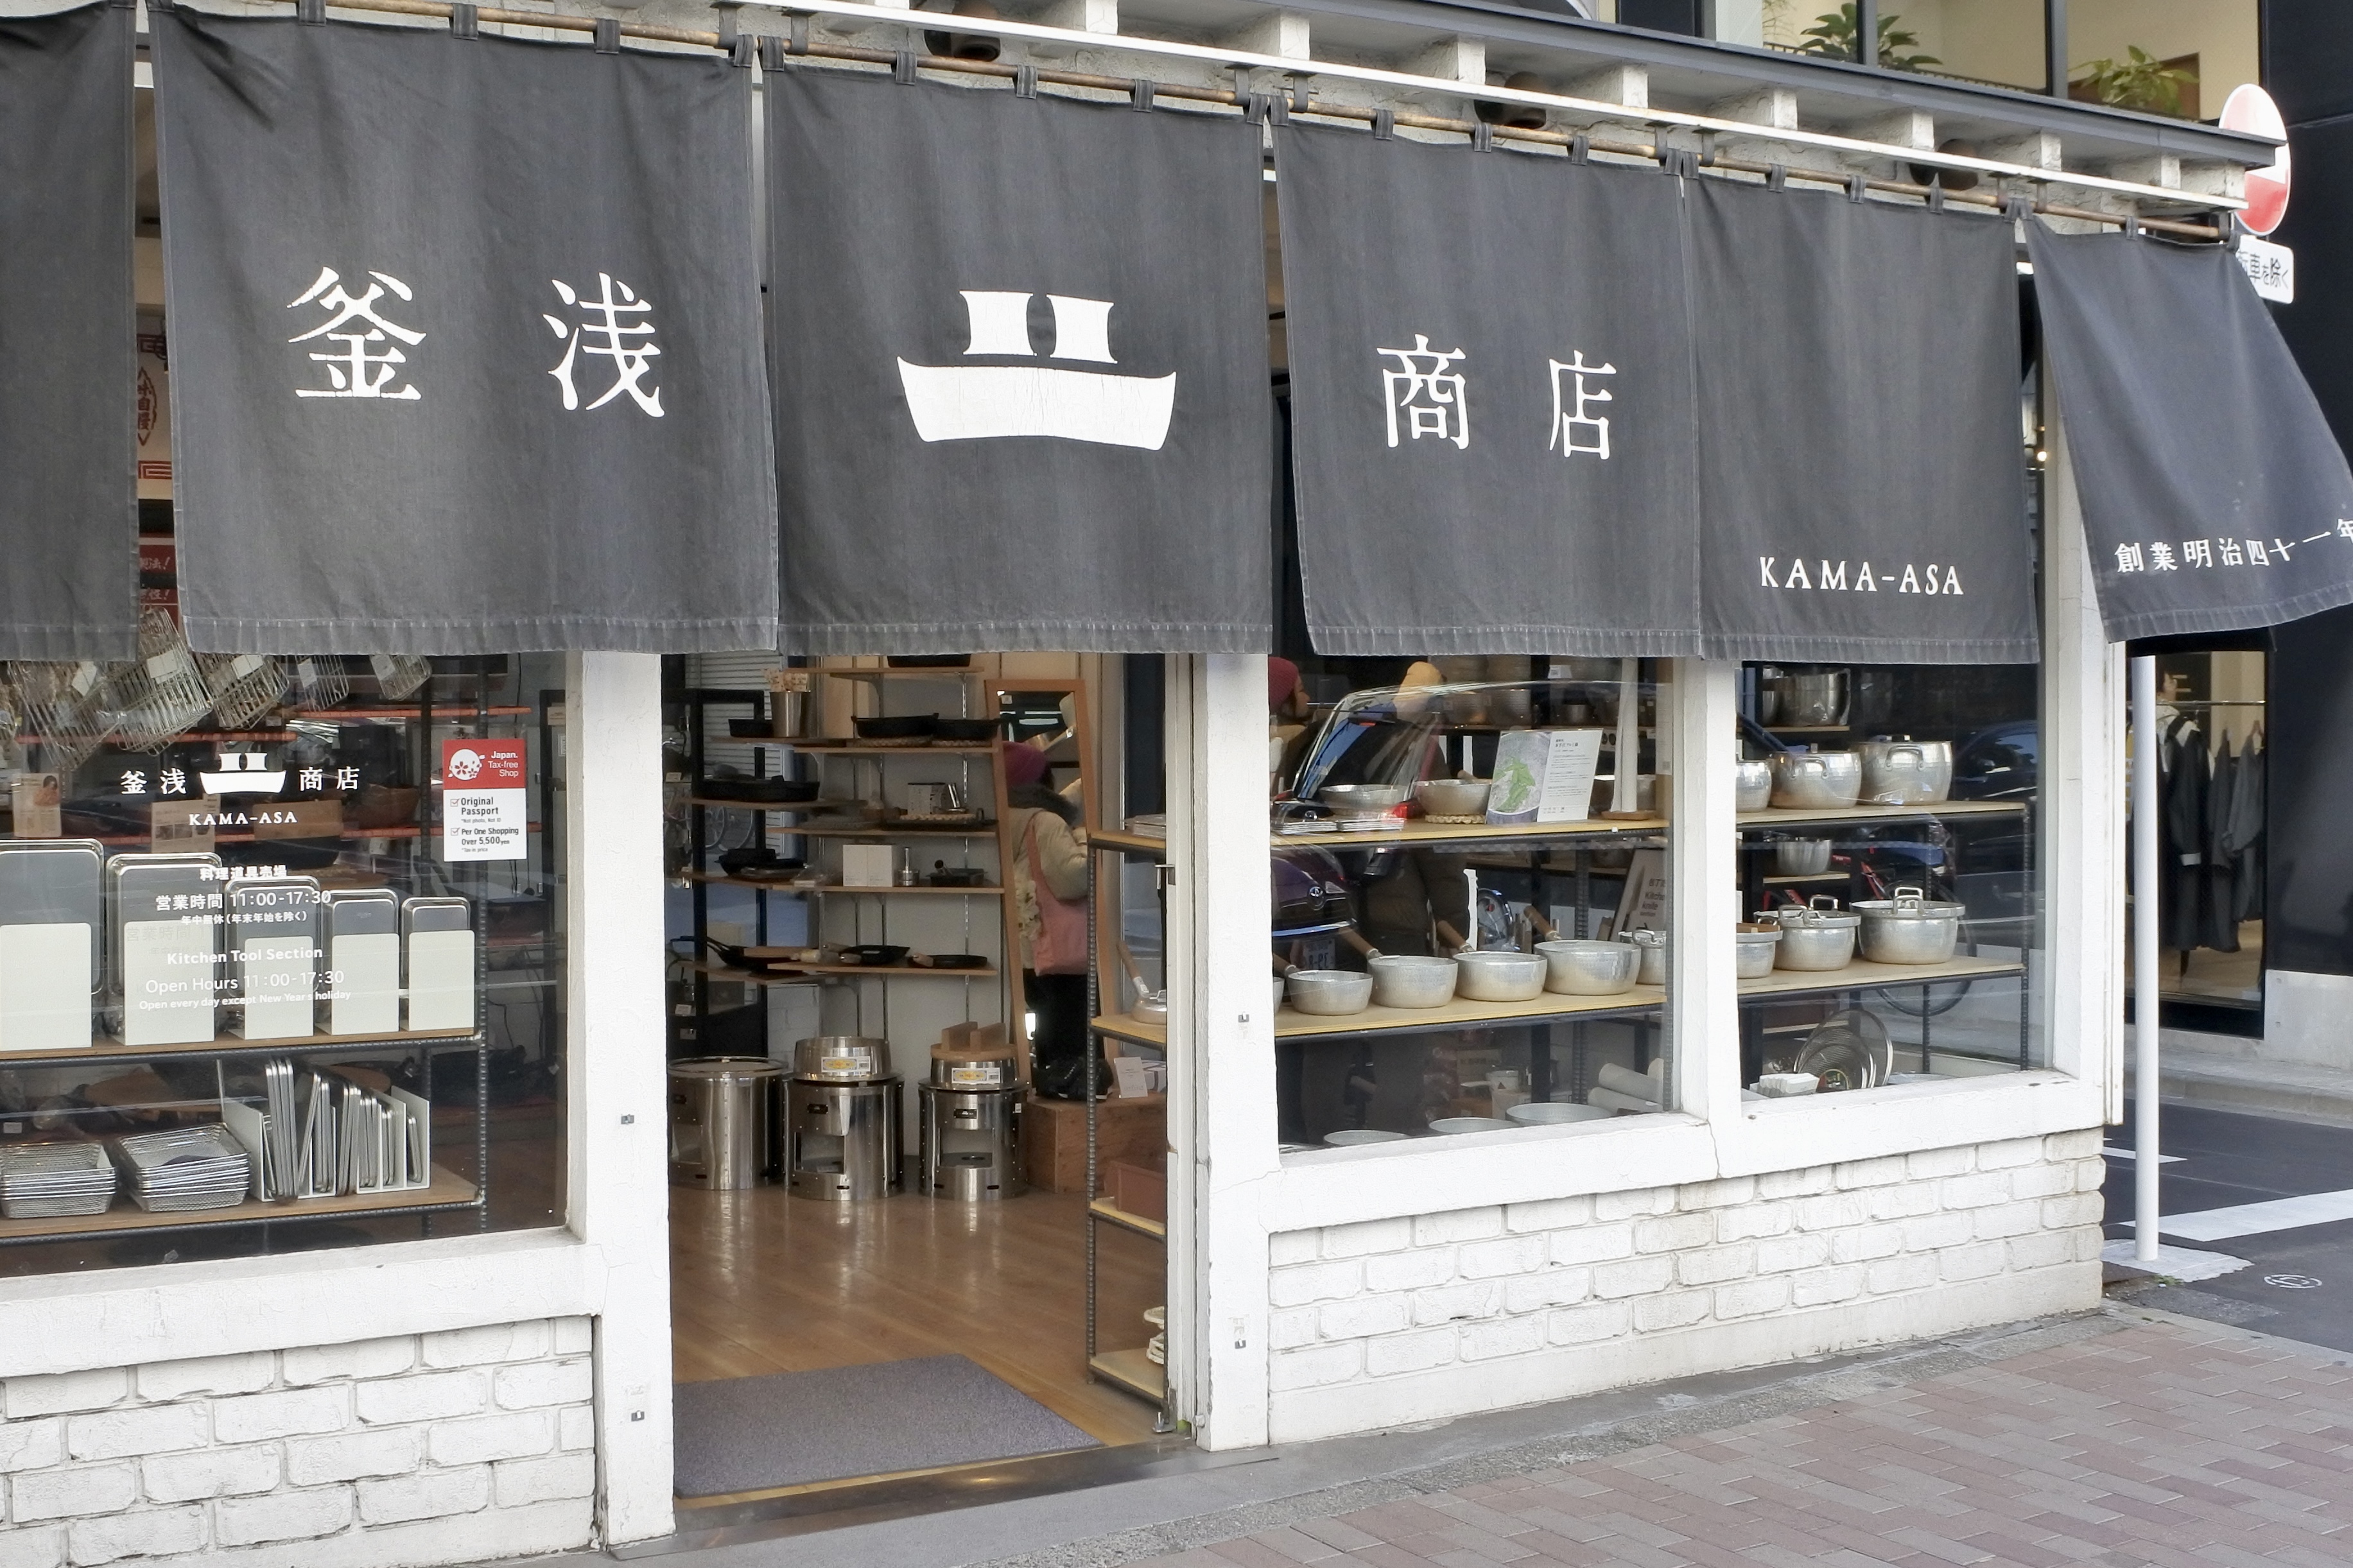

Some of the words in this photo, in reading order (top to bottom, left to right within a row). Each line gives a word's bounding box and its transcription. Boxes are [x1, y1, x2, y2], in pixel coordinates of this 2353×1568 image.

[2237, 250, 2289, 289] 車を除く
[1759, 556, 1965, 596] KAMA-ASA
[491, 751, 518, 760] Japan.
[488, 761, 519, 769] Tax-free
[499, 769, 519, 777] Shop
[460, 797, 494, 807] Original
[189, 812, 298, 826] KAMA-ASA
[461, 807, 499, 816] Passport
[488, 827, 519, 836] Shopping
[200, 865, 288, 881] 料理道具売場
[155, 893, 223, 911] 営業時間
[230, 890, 332, 908] 11:00-17:30
[168, 951, 227, 965] Kitchen
[230, 949, 263, 963] Tool
[266, 947, 324, 960] Section
[145, 979, 188, 995] Open
[192, 978, 238, 992] Hours
[244, 970, 345, 988] 11:00-17:30
[139, 1001, 168, 1012] Open
[170, 1000, 198, 1009] every
[201, 997, 220, 1008] day
[221, 996, 257, 1007] except
[259, 995, 281, 1004] New
[315, 990, 351, 1001] holiday
